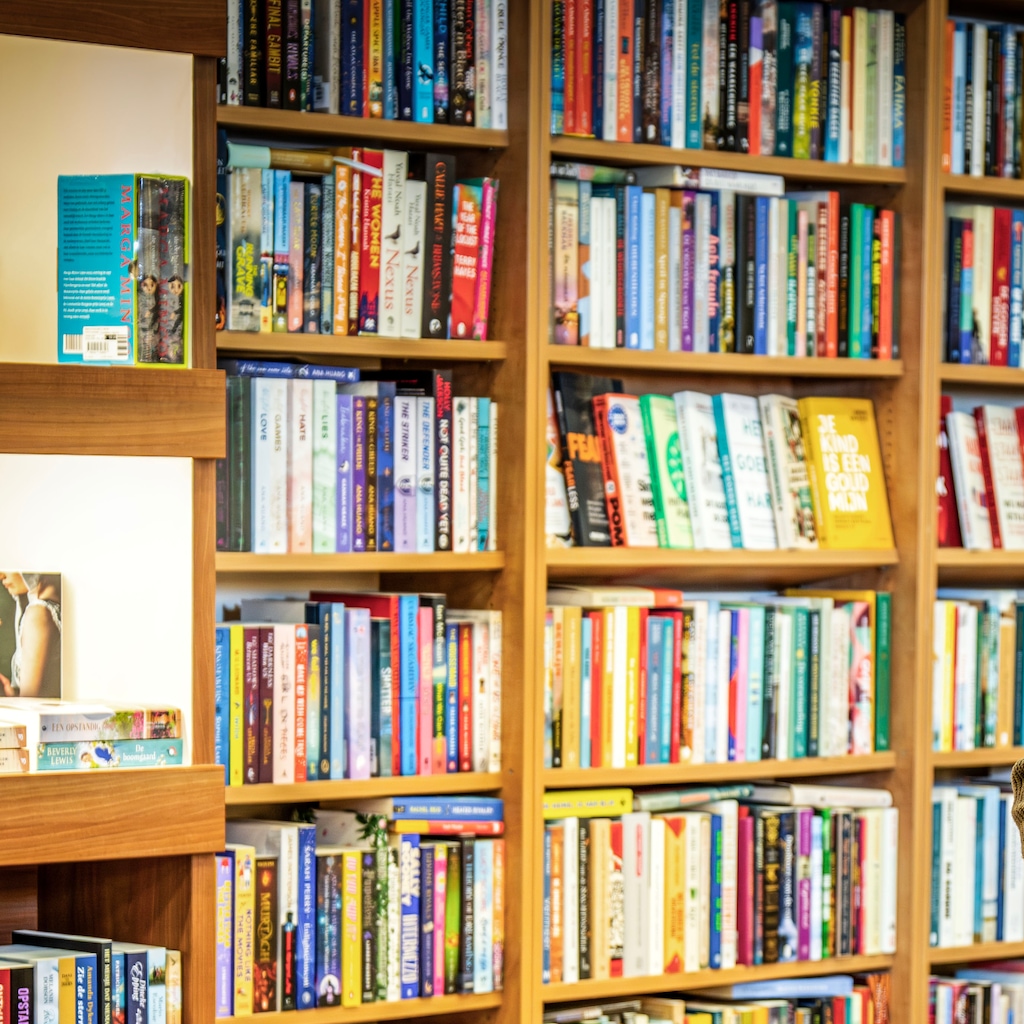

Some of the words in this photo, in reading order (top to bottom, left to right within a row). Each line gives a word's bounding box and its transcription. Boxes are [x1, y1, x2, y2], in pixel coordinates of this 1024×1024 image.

[287, 42, 298, 80] RIVALS
[120, 185, 132, 268] MARGA
[368, 205, 382, 268] WOMEN
[454, 254, 477, 266] TERRY
[384, 250, 400, 311] Nexus
[454, 267, 476, 279] HAYES
[404, 265, 419, 317] Nexus
[260, 413, 268, 442] LOVE
[299, 413, 307, 441] HATE
[438, 419, 449, 442] NOT
[820, 435, 859, 453] KIND
[438, 445, 450, 479] QUITE
[823, 454, 839, 472] IS
[842, 454, 871, 473] EEN
[826, 473, 869, 492] GOUD
[438, 481, 449, 511] DEAD
[828, 493, 868, 513] MIJN
[438, 512, 449, 531] YET
[47, 747, 77, 757] BEVERLY
[51, 756, 74, 765] LEWIS
[123, 752, 156, 762] boomgaard
[77, 967, 85, 981] Zie
[77, 983, 85, 996] de
